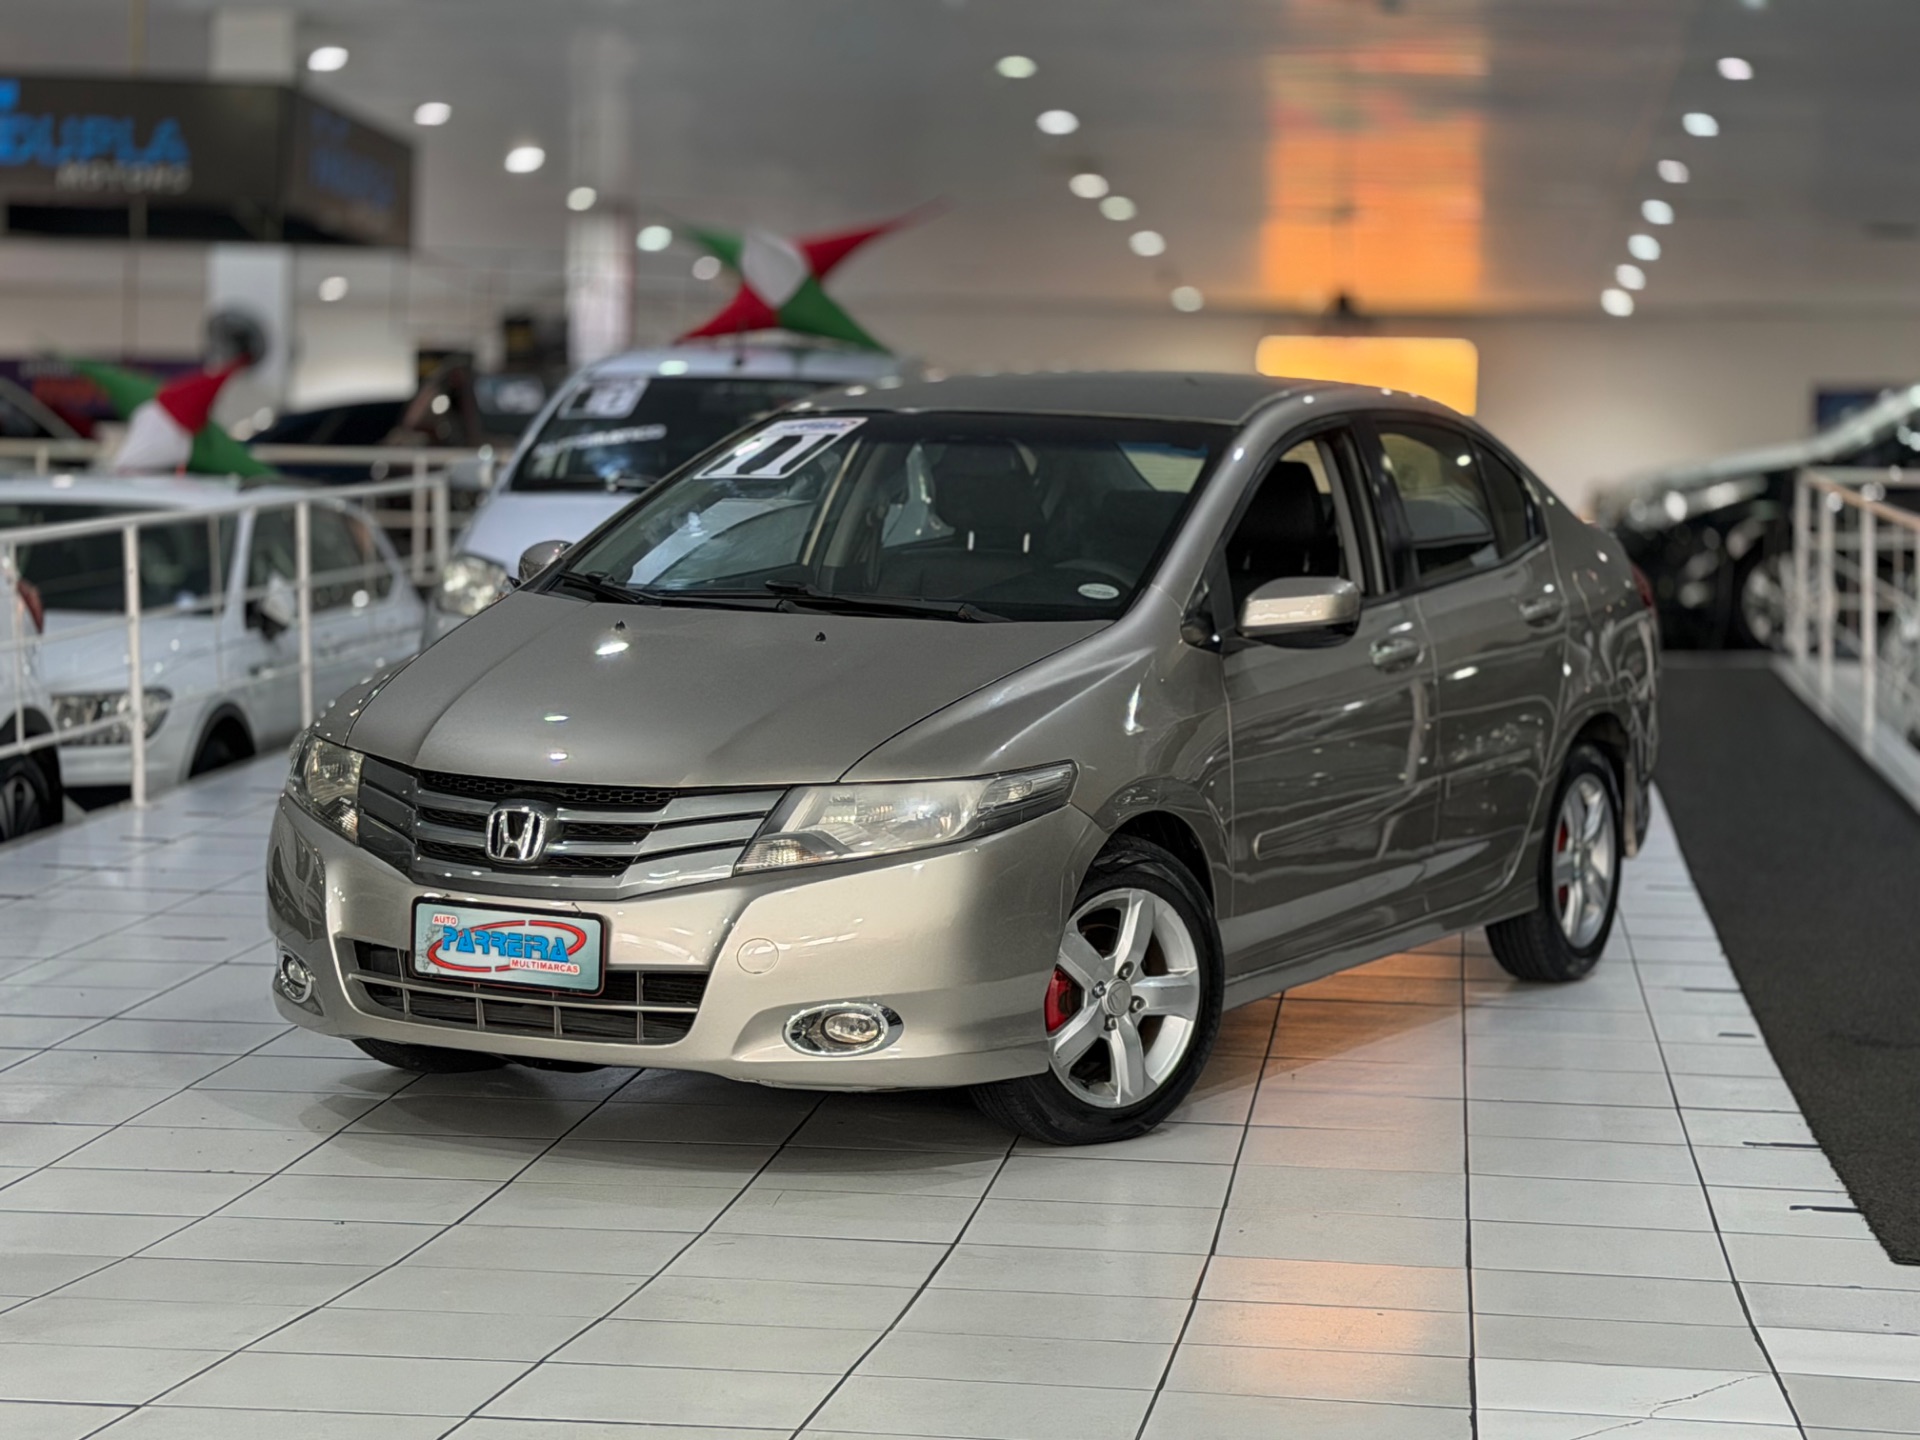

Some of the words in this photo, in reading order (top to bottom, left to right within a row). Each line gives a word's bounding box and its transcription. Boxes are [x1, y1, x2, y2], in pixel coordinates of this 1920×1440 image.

[433, 915, 457, 925] AUTO
[442, 926, 568, 962] PARREIRA
[511, 960, 578, 973] MULTIMARCAS
